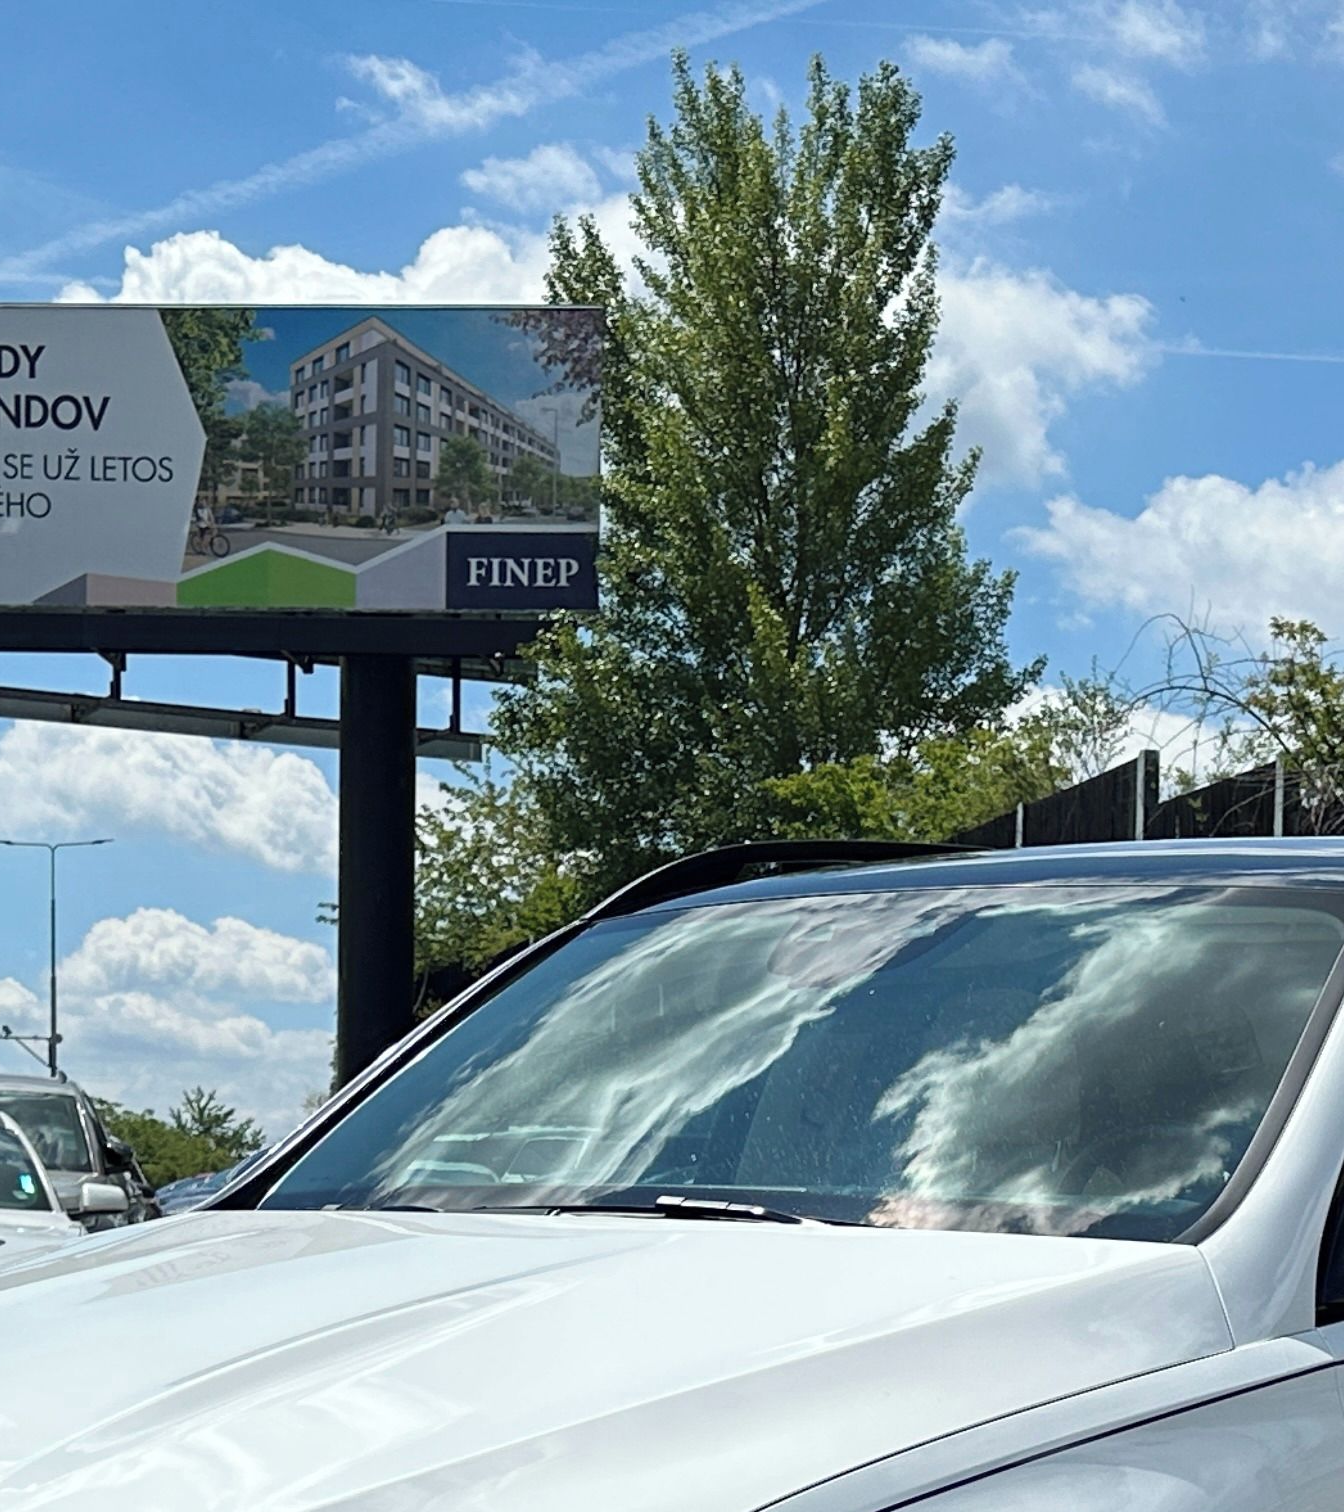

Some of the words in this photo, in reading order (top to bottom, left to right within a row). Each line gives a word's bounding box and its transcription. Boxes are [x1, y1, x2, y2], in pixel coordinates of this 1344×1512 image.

[2, 452, 34, 480] SE
[43, 447, 81, 482] UŽ
[90, 455, 174, 484] LETOS
[466, 557, 580, 588] FINEP
